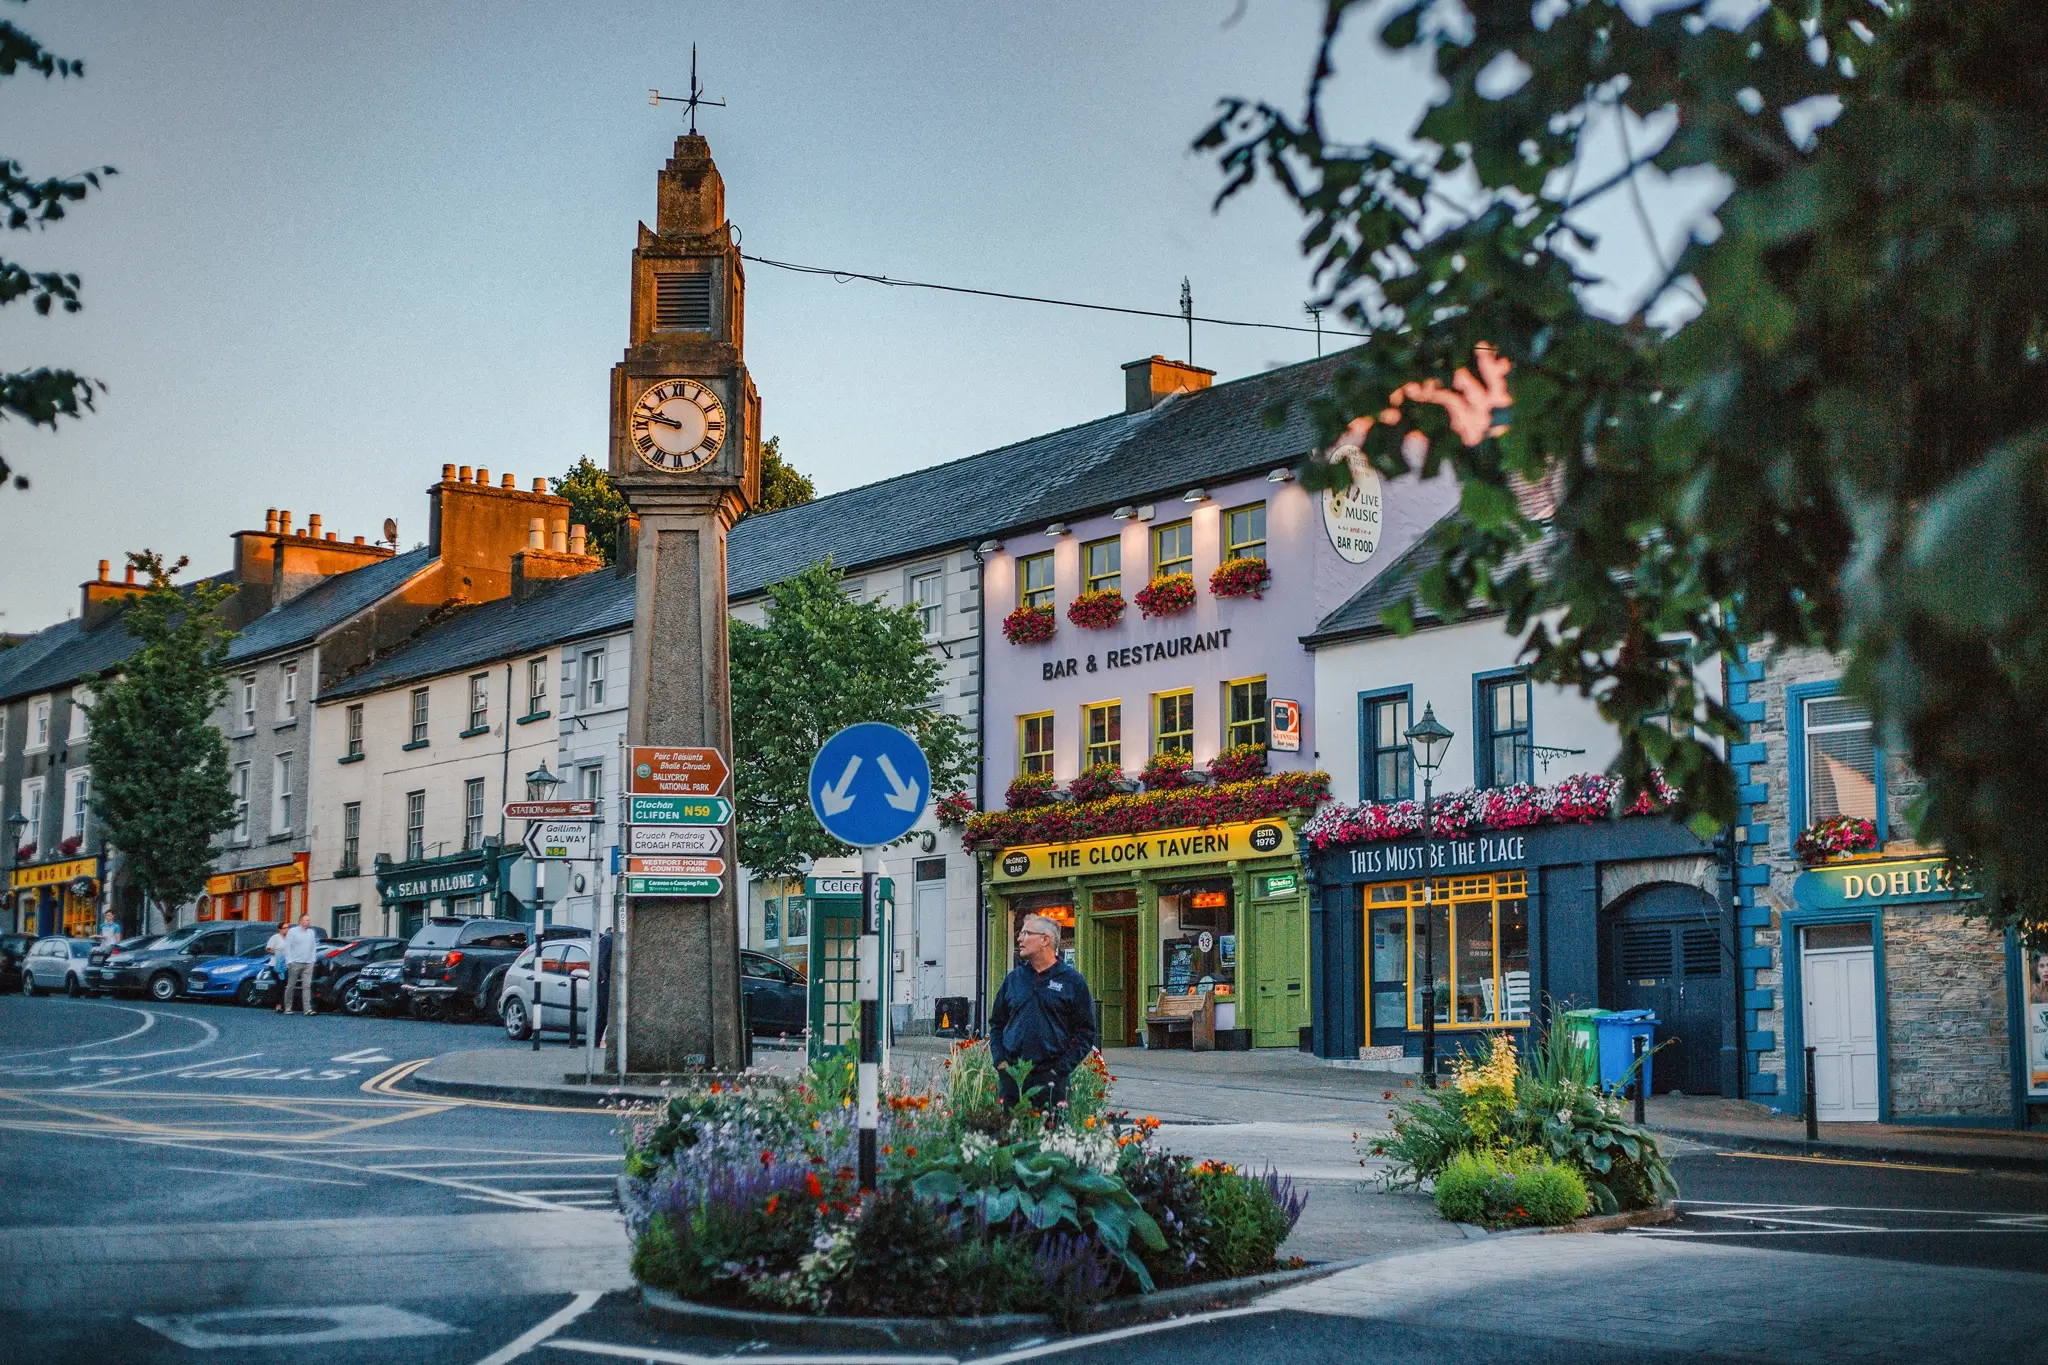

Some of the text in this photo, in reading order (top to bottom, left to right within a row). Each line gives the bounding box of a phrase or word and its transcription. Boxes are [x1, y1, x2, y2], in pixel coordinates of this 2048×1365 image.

[1361, 493, 1379, 508] LIVE
[1345, 506, 1378, 524] MUSIC
[1337, 536, 1374, 553] BAR FOOD
[1042, 628, 1232, 681] BAR & RESTAURANT
[652, 773, 689, 781] BALLYCROY
[659, 782, 710, 791] NATIONAL PARK
[511, 806, 544, 815] STATION
[635, 811, 680, 819] CLIFDEN
[684, 805, 711, 817] N59
[546, 824, 582, 833] Gaillimh
[635, 831, 666, 840] Cruach
[1256, 829, 1276, 838] ESTD.
[545, 835, 587, 843] GALWAY
[1255, 837, 1276, 847] 1976
[634, 841, 705, 850] CROAGH PATRICK
[545, 847, 567, 856] N84
[1047, 833, 1229, 869] THE CLOCK TAVERN
[1010, 865, 1023, 873] BAR
[399, 873, 475, 897] SEAN MALONE
[1200, 939, 1210, 948] 13
